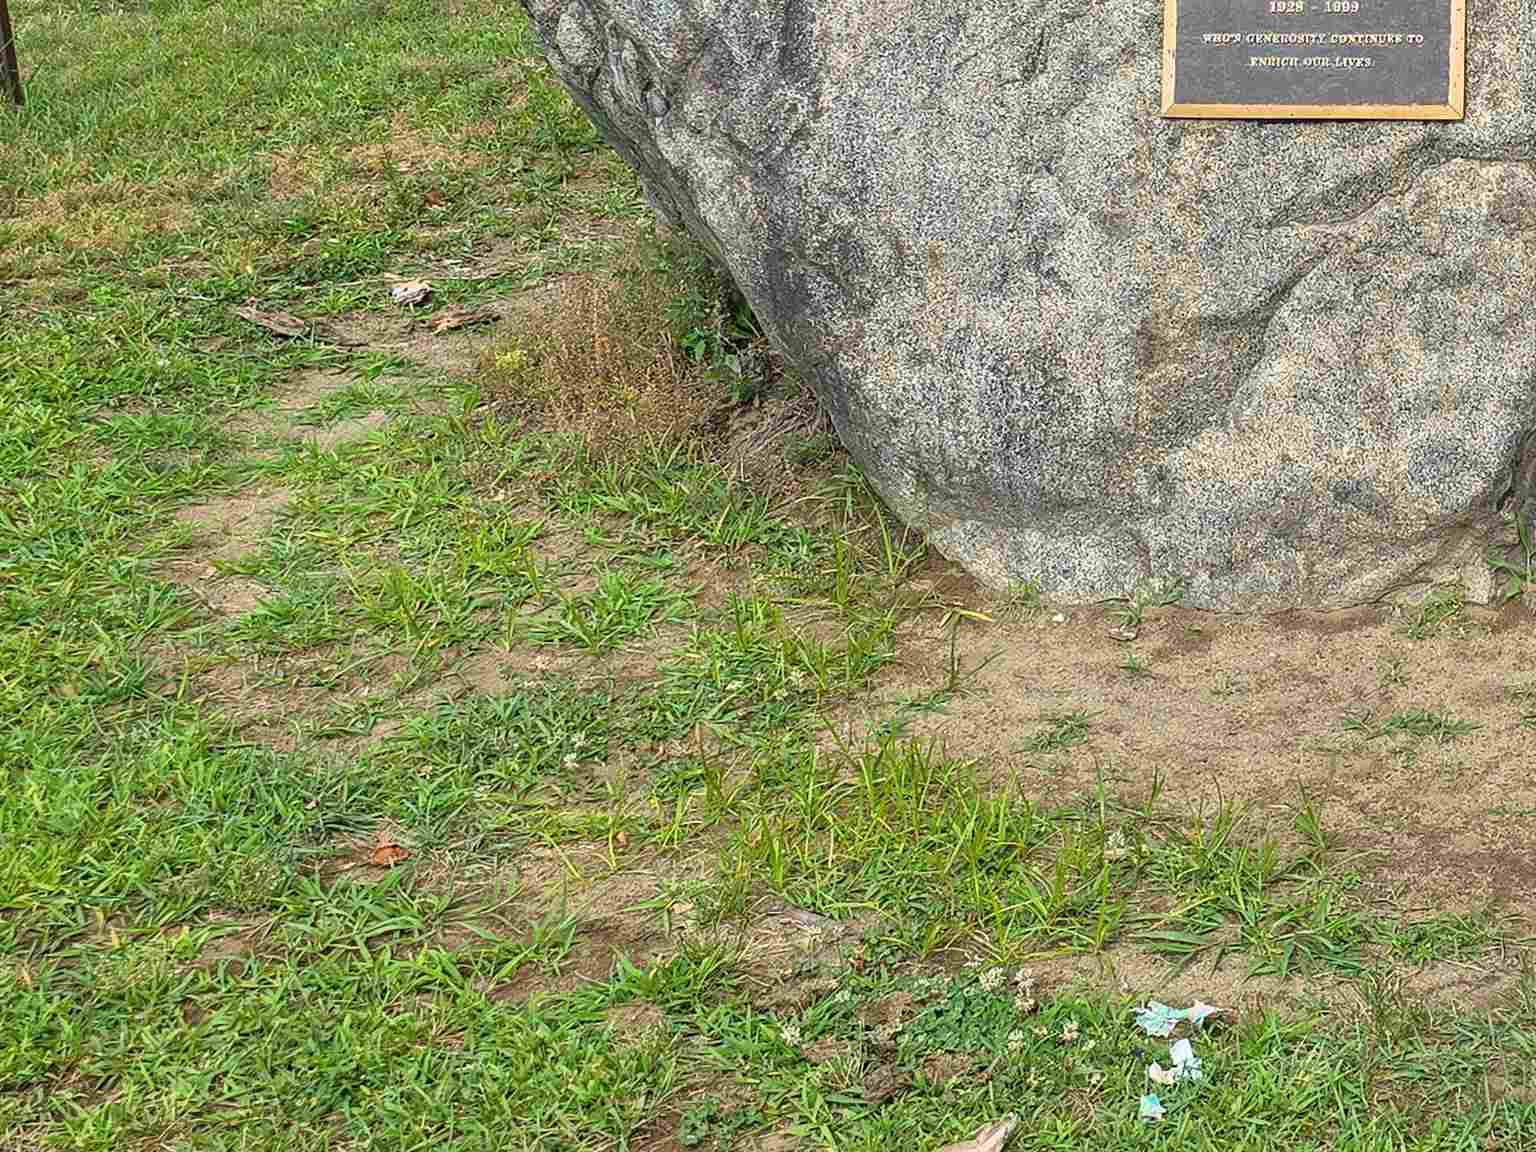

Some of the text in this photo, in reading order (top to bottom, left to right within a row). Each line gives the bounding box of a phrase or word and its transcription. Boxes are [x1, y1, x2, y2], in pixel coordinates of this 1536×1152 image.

[1245, 33, 1327, 44] GENEROSITY
[1407, 33, 1425, 43] TO
[1302, 56, 1331, 67] OUR
